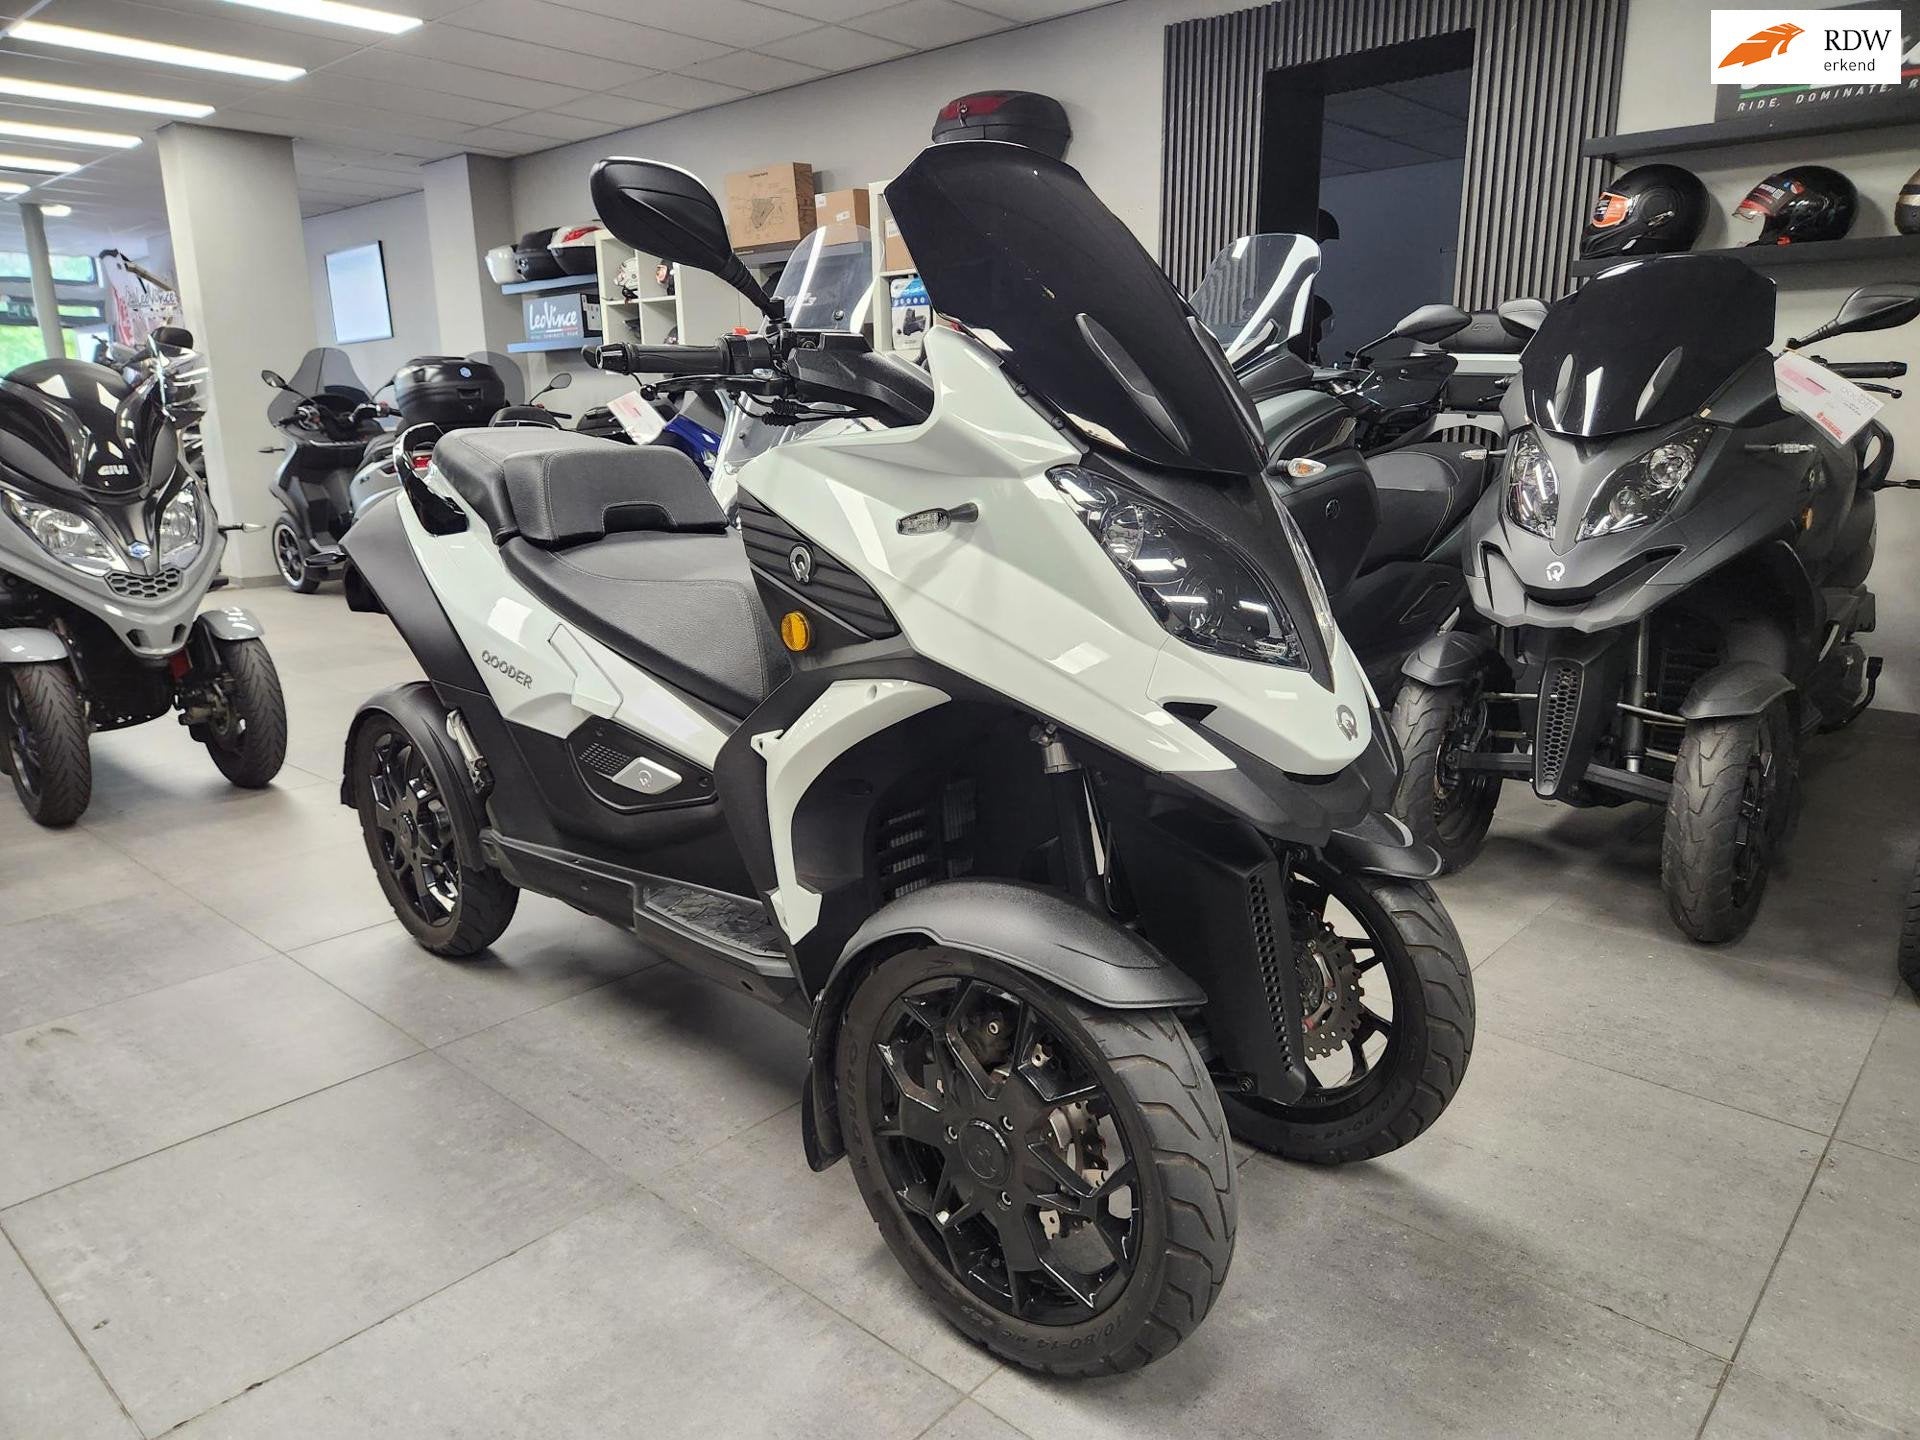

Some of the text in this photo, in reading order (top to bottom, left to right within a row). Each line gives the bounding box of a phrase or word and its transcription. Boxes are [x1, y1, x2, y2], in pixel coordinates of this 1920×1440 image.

[529, 301, 578, 330] LeoVince
[98, 464, 129, 476] GIVI
[481, 650, 532, 689] QOODER
